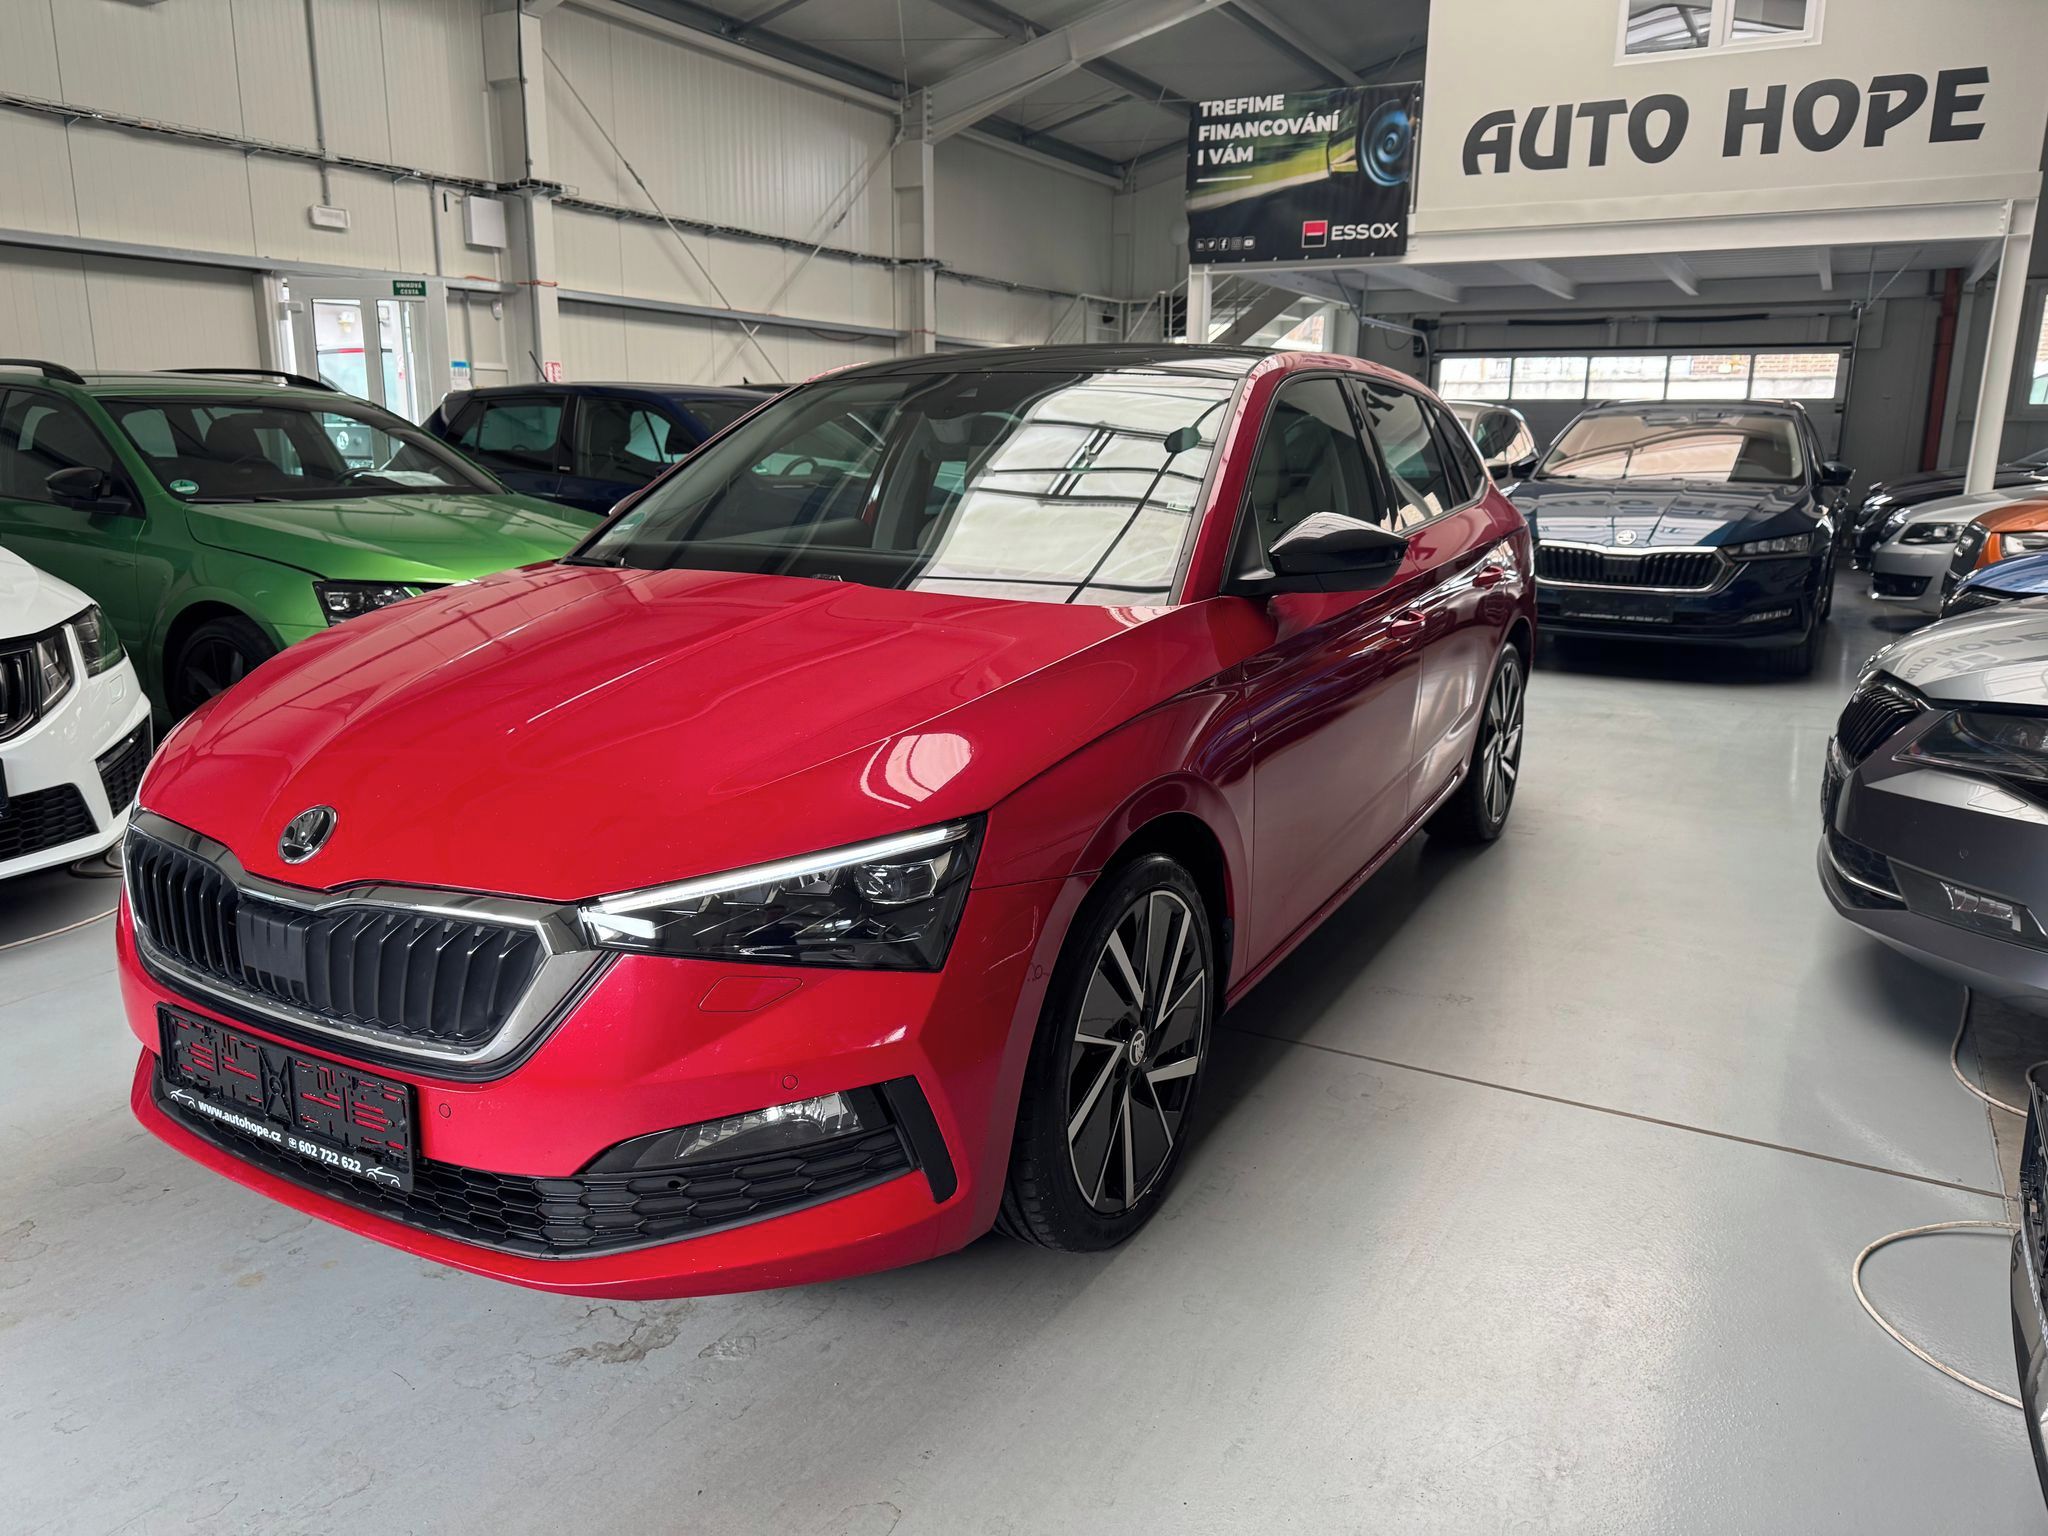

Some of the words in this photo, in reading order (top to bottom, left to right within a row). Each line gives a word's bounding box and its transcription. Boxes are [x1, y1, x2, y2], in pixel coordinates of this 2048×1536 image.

[1199, 94, 1284, 117] TREFIME
[1199, 110, 1341, 141] FINANCOVÁNÍ
[1462, 93, 1690, 175] AUTO
[1722, 66, 1989, 157] HOPE
[1197, 151, 1204, 165] I
[1209, 143, 1254, 165] VÁM
[1331, 222, 1399, 240] ESSOX
[198, 1101, 282, 1142] www.autohope.cz
[298, 1141, 318, 1157] 602
[320, 1147, 339, 1166] 722
[341, 1156, 362, 1172] 622
